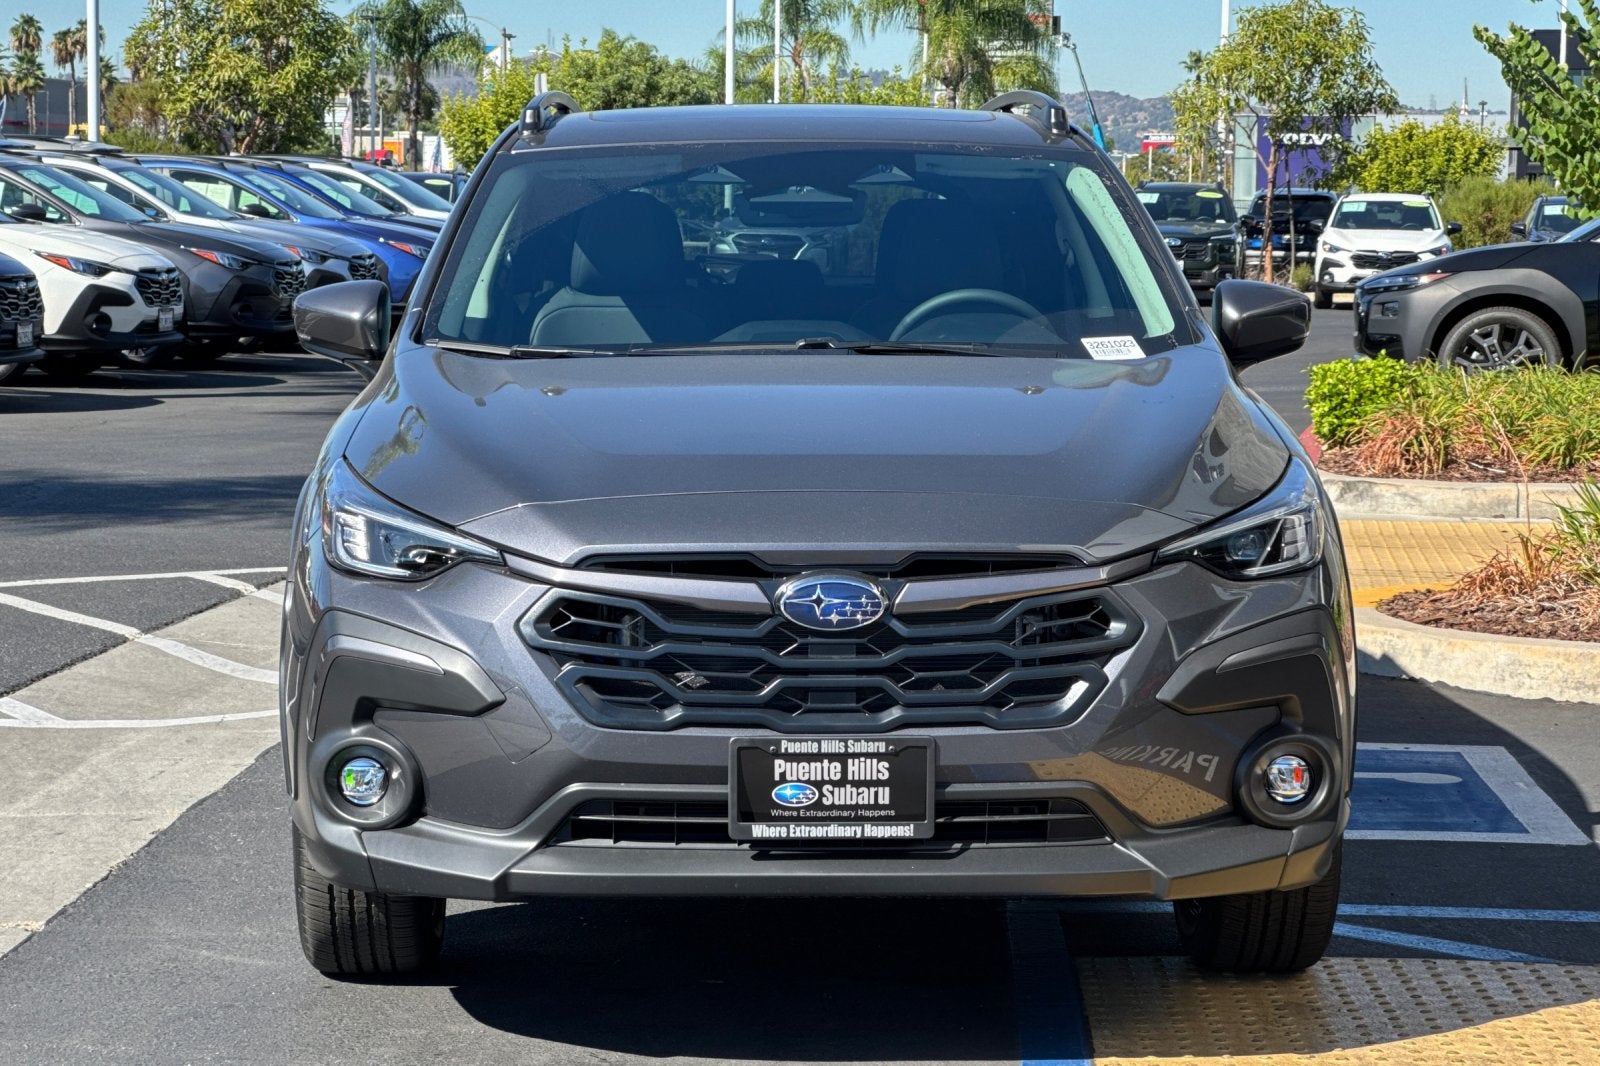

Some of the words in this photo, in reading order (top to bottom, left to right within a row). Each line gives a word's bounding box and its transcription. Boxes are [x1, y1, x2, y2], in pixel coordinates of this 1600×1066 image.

[1086, 340, 1136, 349] 3261023
[781, 740, 819, 753] Puente
[821, 739, 845, 753] Hills
[847, 740, 886, 753] Subaru
[774, 758, 842, 781] Puente
[847, 757, 890, 781] Hills
[822, 784, 890, 806] Subaru
[770, 809, 798, 817] Where
[799, 809, 856, 818] Extraordinary
[857, 808, 896, 818] Happens
[751, 824, 788, 838] Where
[789, 824, 863, 838] Extraordinary
[863, 823, 915, 839] Happens!
